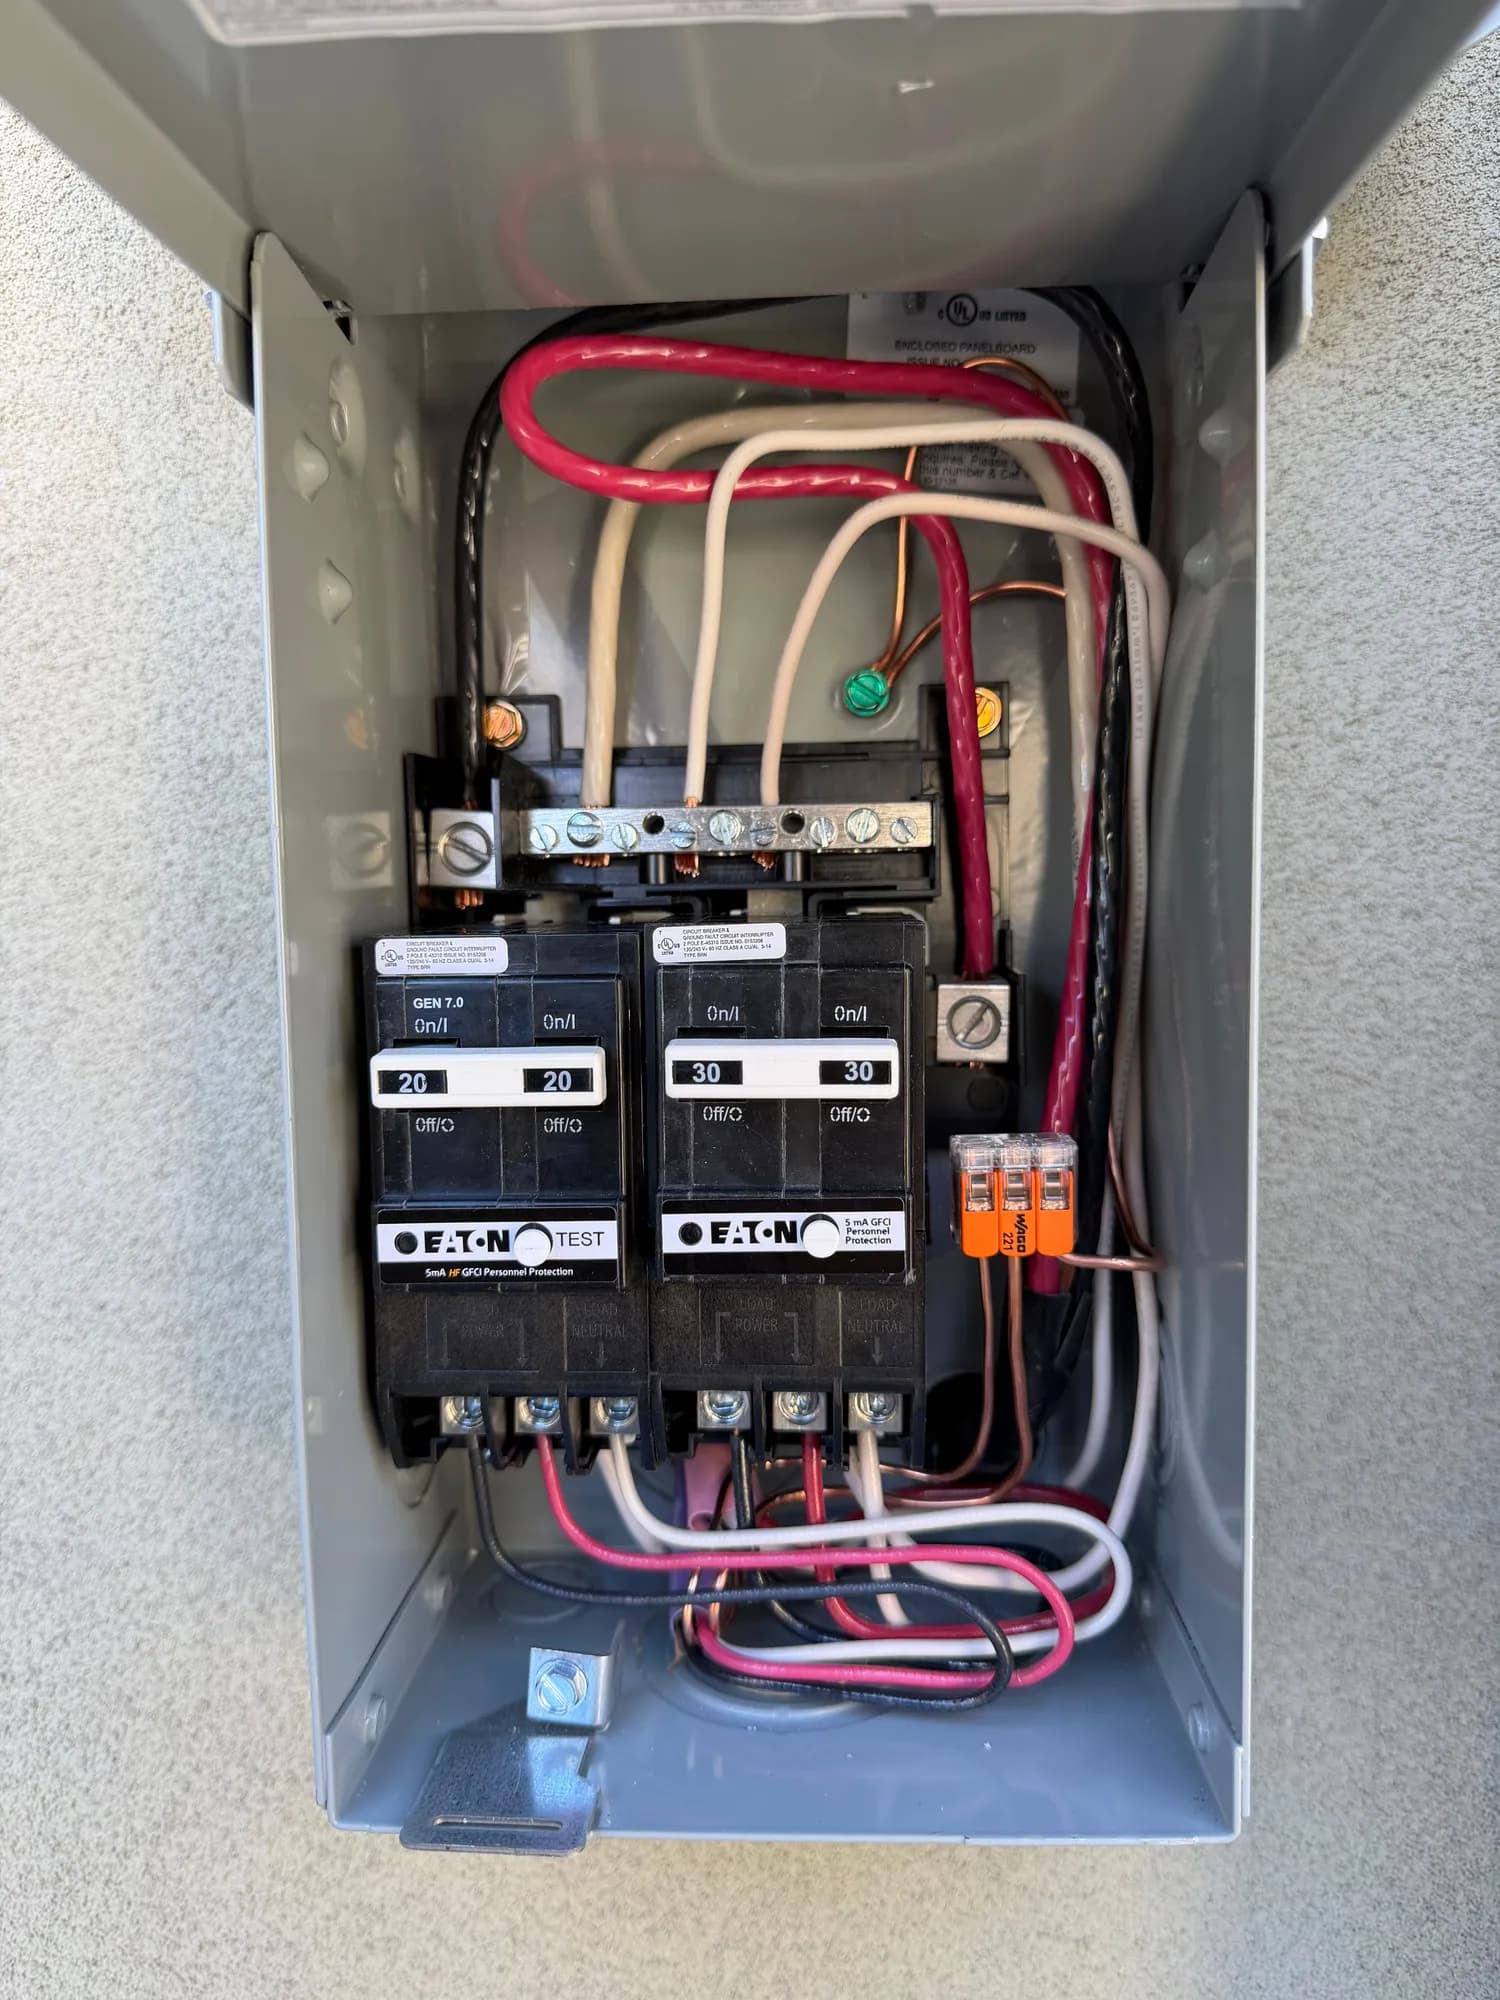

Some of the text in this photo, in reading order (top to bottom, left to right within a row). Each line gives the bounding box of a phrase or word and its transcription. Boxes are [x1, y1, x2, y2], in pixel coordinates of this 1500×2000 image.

[995, 311, 1027, 321] LISTED
[894, 340, 1036, 354] ENCLOSED PANELBOARD
[943, 465, 985, 478] number
[413, 997, 464, 1009] GEN 7.0
[692, 1062, 721, 1083] 30
[844, 1061, 873, 1082] 30
[398, 1072, 428, 1093] 20
[543, 1070, 572, 1091] 20
[845, 1218, 891, 1227] 5 mA GFCI
[711, 1220, 797, 1244] EATON
[846, 1227, 890, 1235] Personnel
[1014, 1214, 1028, 1253] WAGO
[424, 1229, 510, 1253] EATON
[556, 1232, 605, 1247] TEST
[845, 1236, 892, 1245] Protection
[1003, 1232, 1013, 1250] 221
[425, 1266, 574, 1278] 5mA HF GFCI Personnel Protection
[860, 1299, 895, 1311] LOAD
[735, 1318, 778, 1331] POWER
[847, 1319, 904, 1332] NEUTRAL
